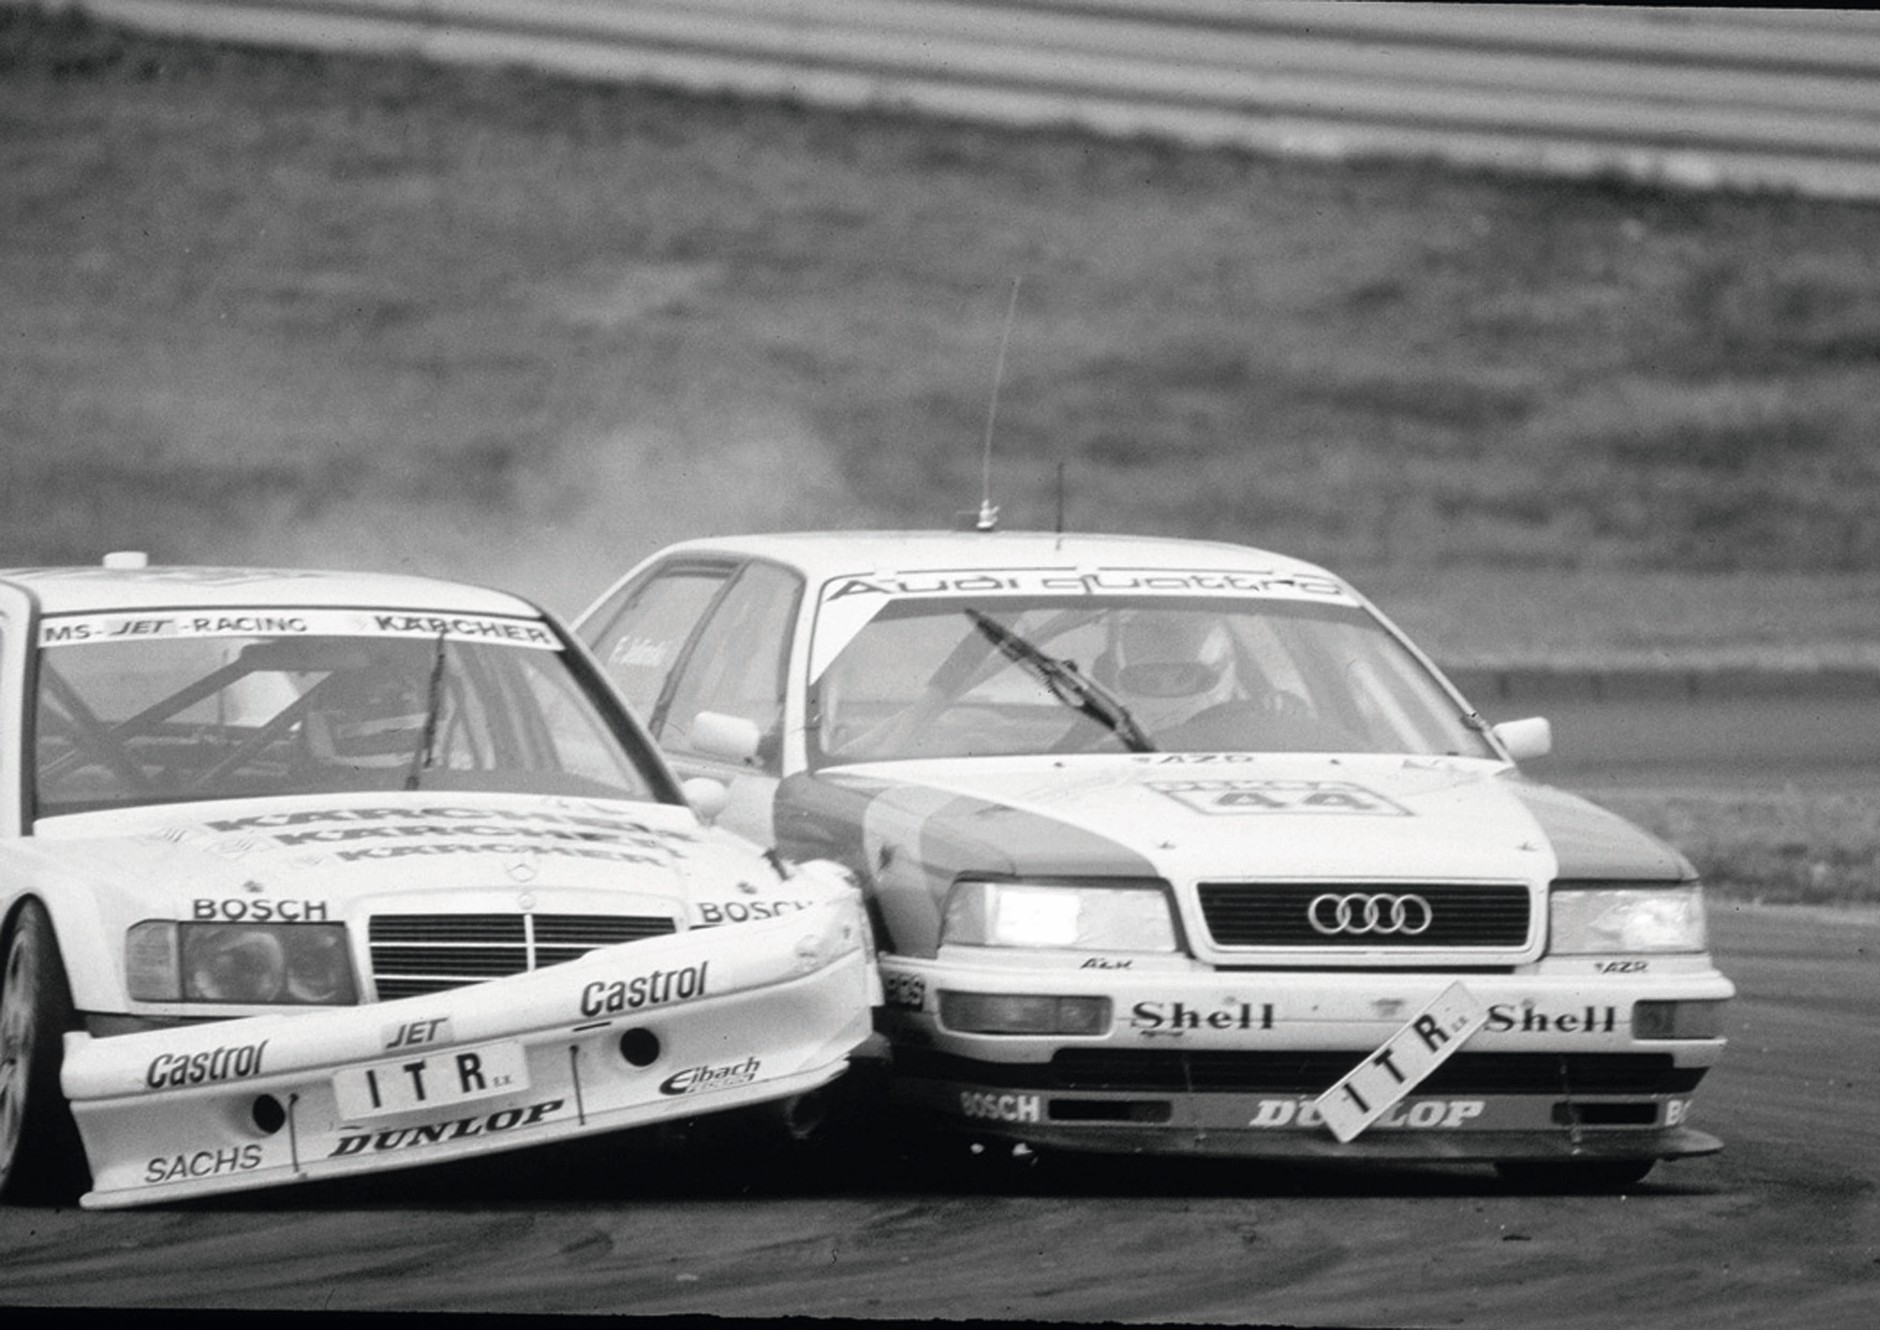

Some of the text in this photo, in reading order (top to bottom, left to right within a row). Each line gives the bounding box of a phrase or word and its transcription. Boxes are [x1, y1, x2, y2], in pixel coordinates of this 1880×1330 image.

[828, 576, 1019, 601] Audi
[193, 899, 328, 921] BOSCH
[580, 960, 709, 1017] Castrol
[1130, 1001, 1274, 1030] Shell
[1484, 1004, 1616, 1033] Shell
[385, 1017, 449, 1050] JET
[146, 1038, 270, 1089] Castrol
[658, 1055, 763, 1096] Eibach
[960, 1091, 1041, 1123] BOSCH
[327, 1099, 566, 1159] DUNLOP
[144, 1143, 263, 1184] SACHS
